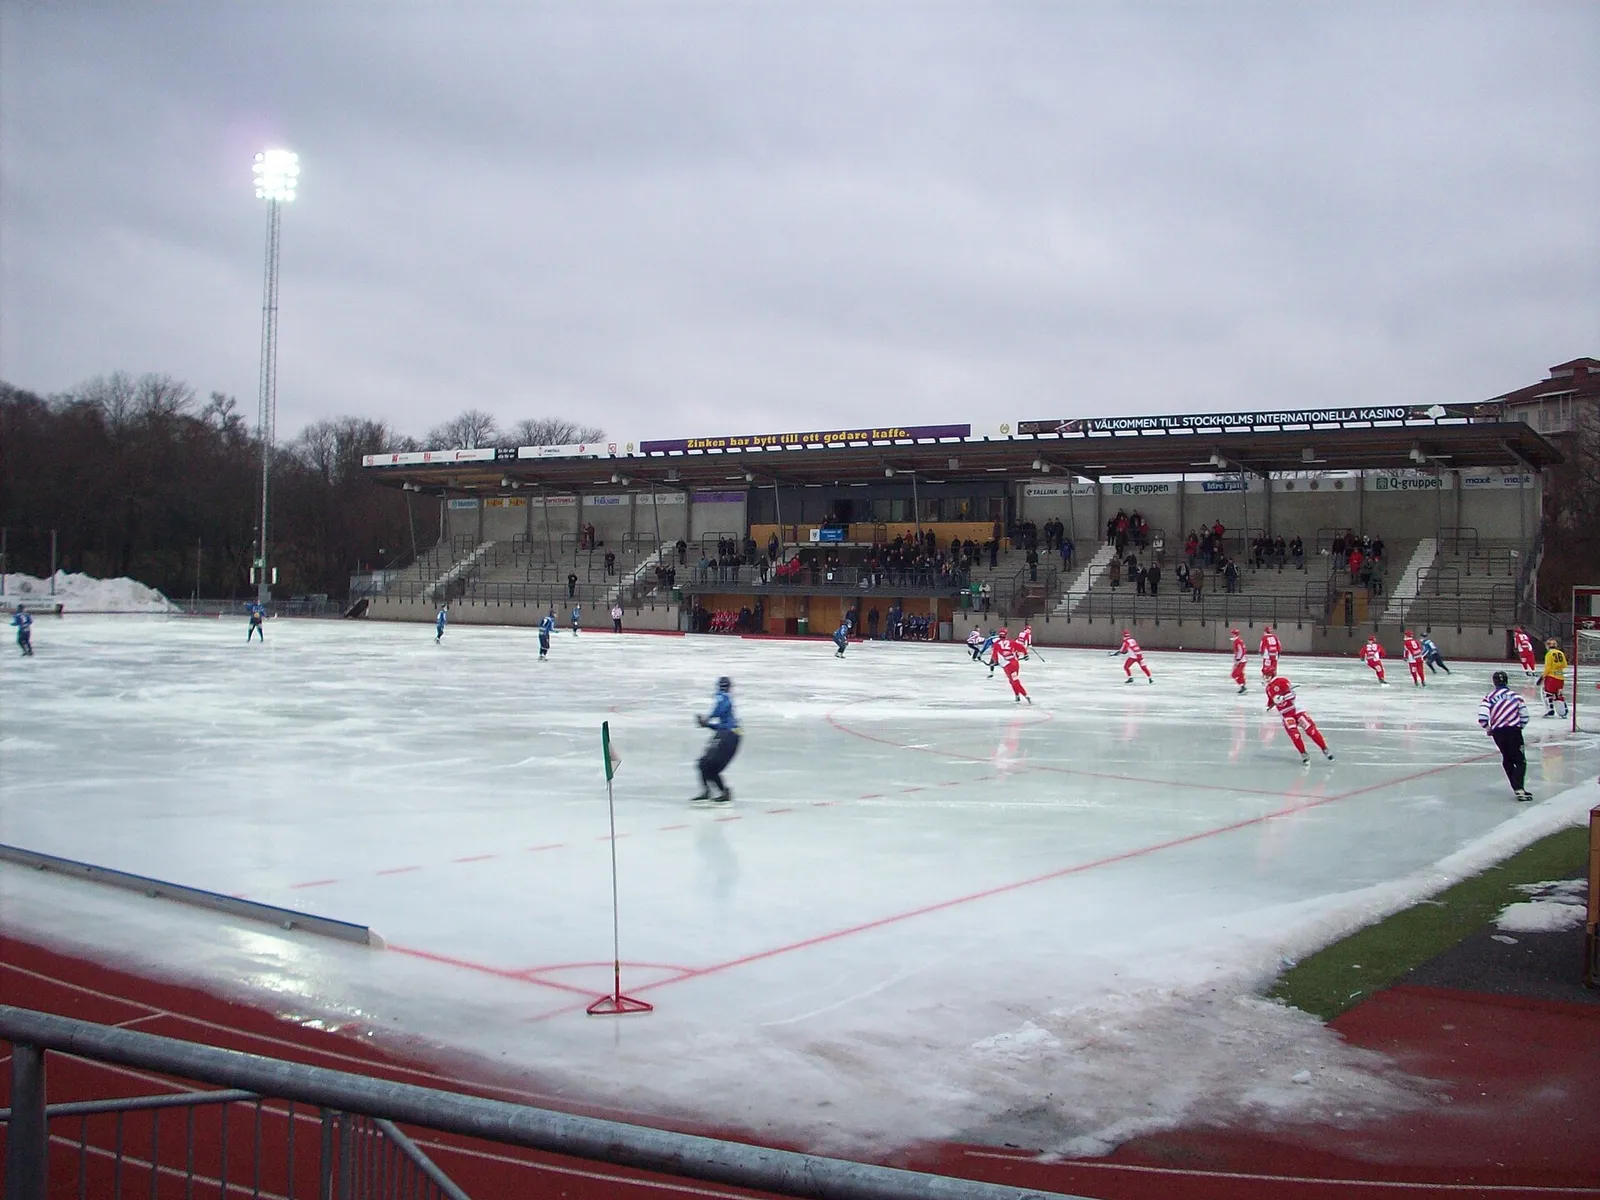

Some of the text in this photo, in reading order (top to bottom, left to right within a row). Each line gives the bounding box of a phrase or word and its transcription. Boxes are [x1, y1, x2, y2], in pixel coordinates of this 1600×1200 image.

[1094, 407, 1405, 430] VÄLKOMMEN TILL STOCKHOLMS INTERNATIONELLA KASINO
[687, 428, 910, 448] Zinken har bytt till ett godare kaffe.
[1124, 483, 1169, 494] Q-gruppen
[1390, 477, 1443, 490] Q-gruppen
[998, 639, 1011, 650] 12
[1552, 652, 1564, 663] 36
